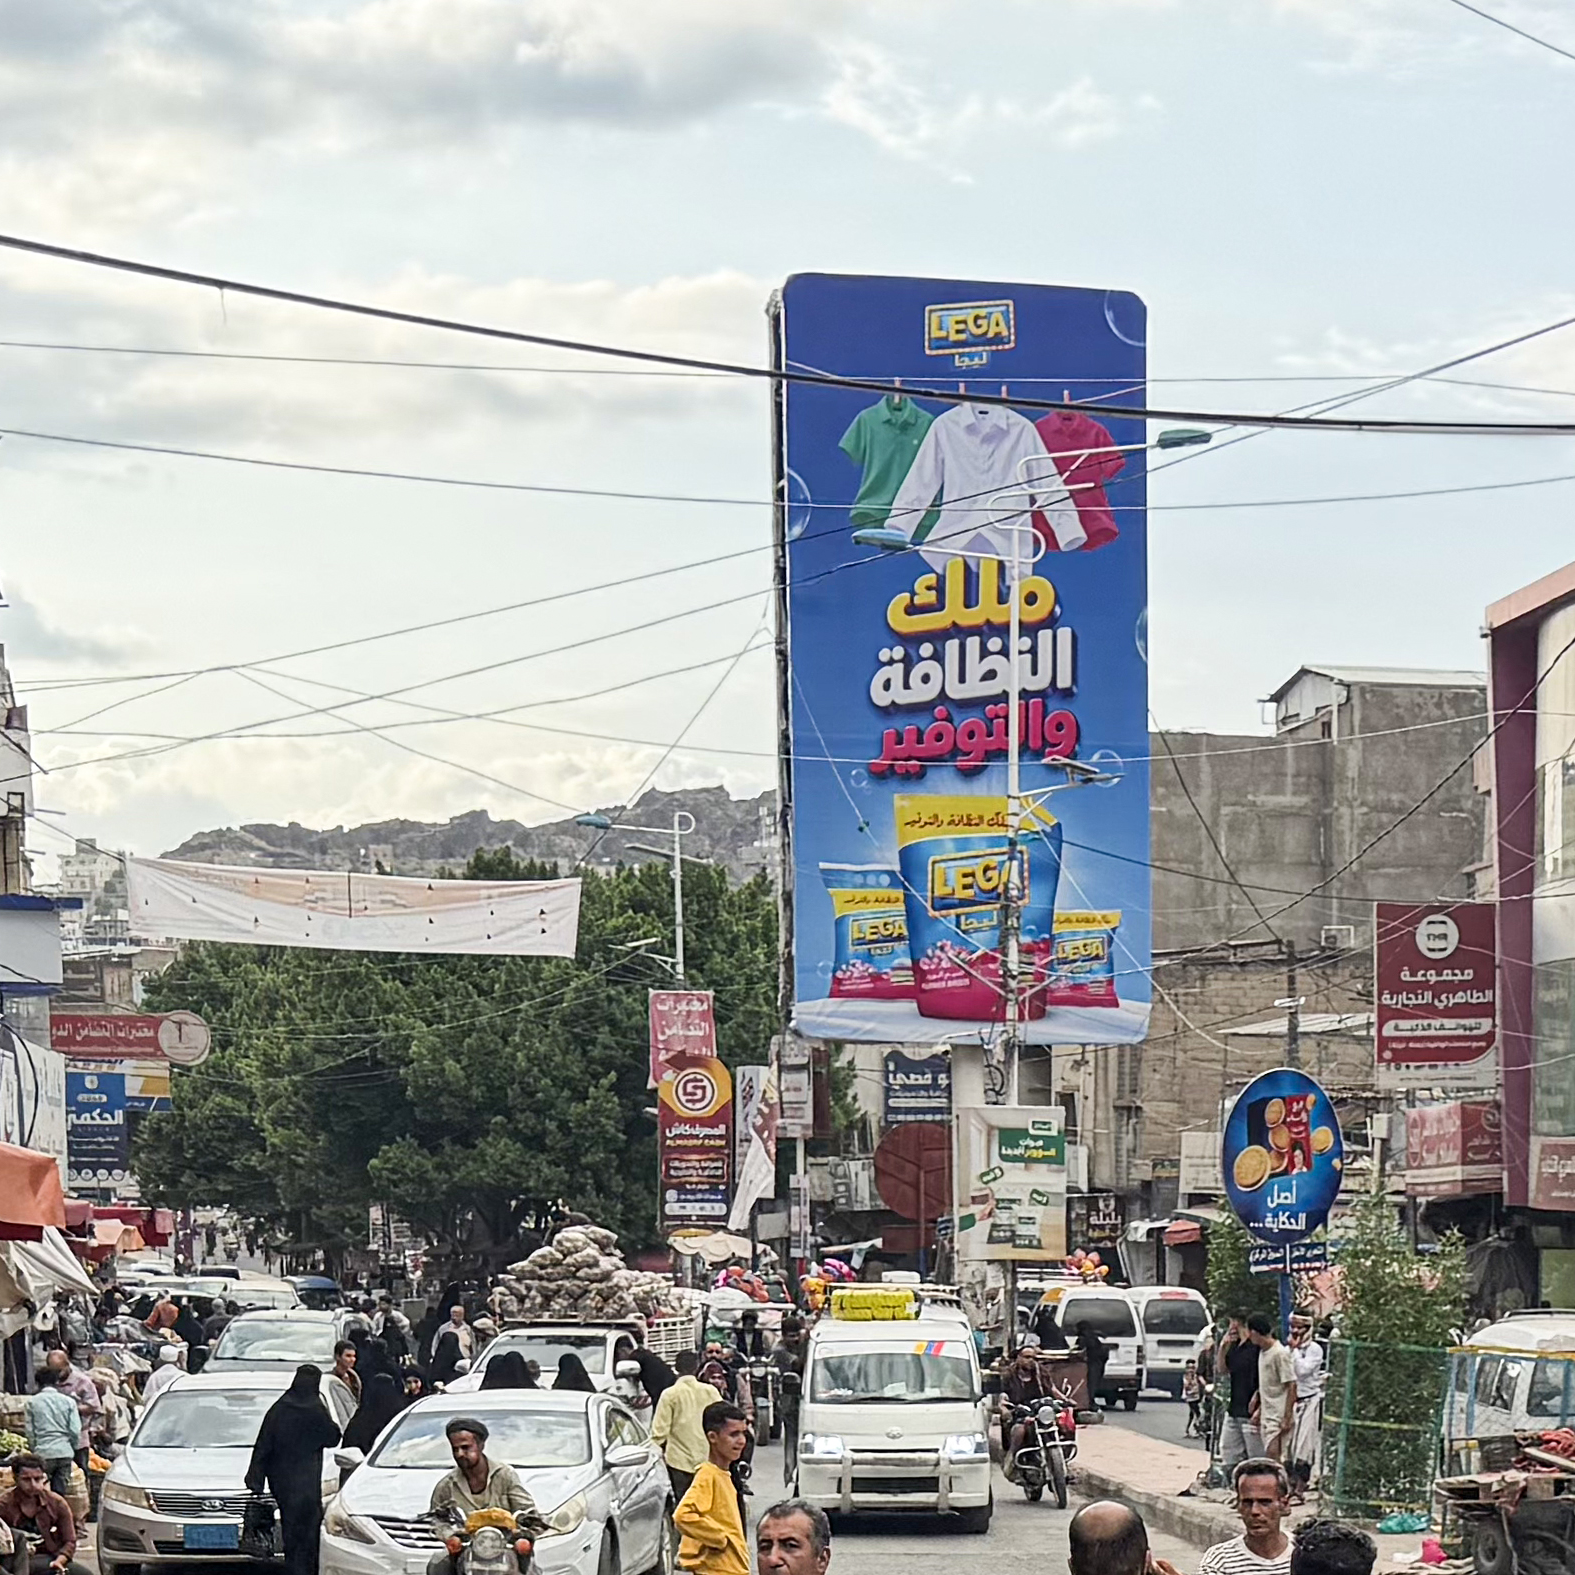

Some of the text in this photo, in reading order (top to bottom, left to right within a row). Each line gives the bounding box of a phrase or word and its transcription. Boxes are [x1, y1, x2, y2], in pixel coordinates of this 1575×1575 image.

[930, 309, 1011, 342] LEGA
[887, 557, 1059, 634] ملك
[870, 626, 1075, 707] النظافة
[869, 698, 1078, 775] والتوفير
[987, 811, 1015, 829] لك
[852, 918, 907, 942] LEGA
[1057, 940, 1105, 961] LEGA
[1399, 966, 1474, 986] مجموعة
[1381, 988, 1494, 1010] الطاهري التجارية
[1267, 1180, 1297, 1208] أصل
